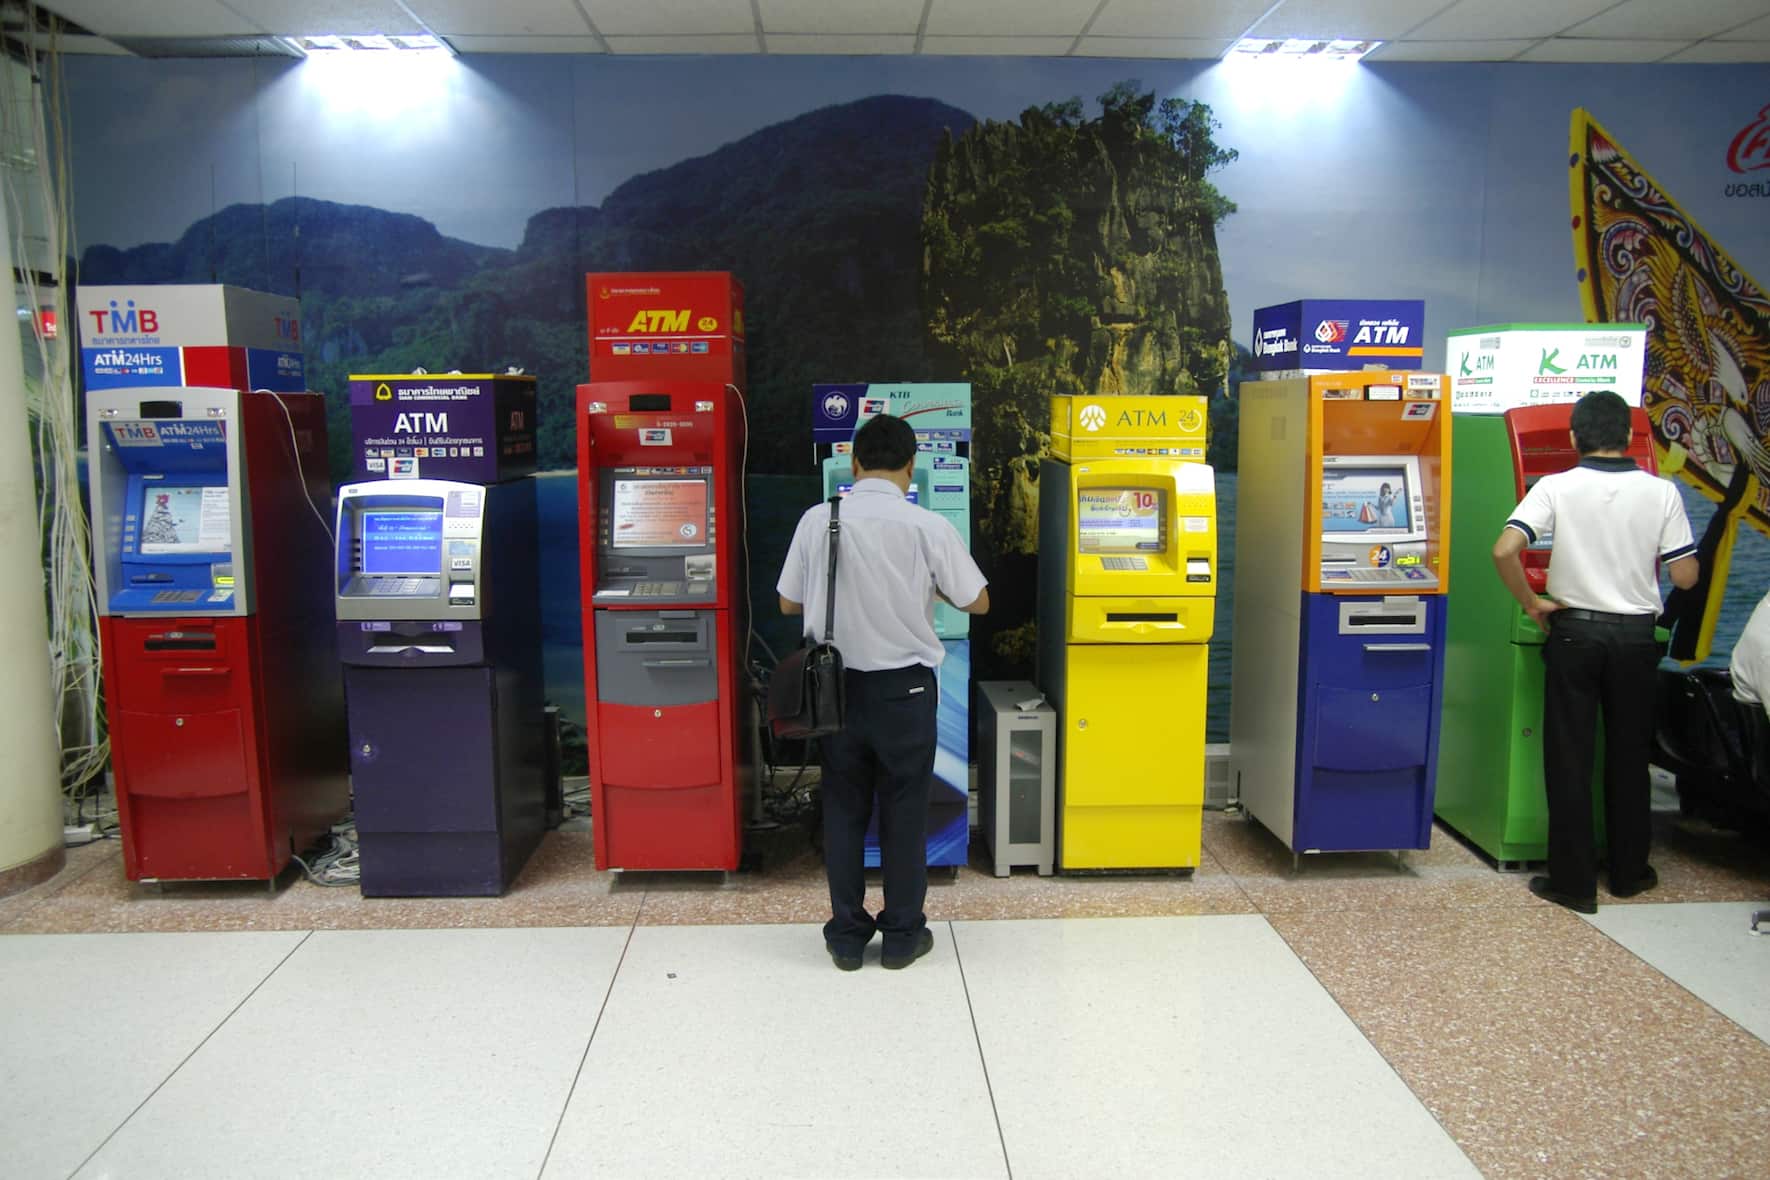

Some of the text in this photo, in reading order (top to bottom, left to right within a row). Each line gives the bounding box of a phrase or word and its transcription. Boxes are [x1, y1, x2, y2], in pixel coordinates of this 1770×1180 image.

[89, 300, 160, 335] TMB
[626, 309, 692, 333] ATM
[1353, 326, 1409, 344] ATM
[1476, 355, 1494, 370] ATM
[1538, 347, 1617, 375] K ATM
[889, 391, 911, 399] KTB
[394, 413, 448, 433] ATM
[1116, 409, 1194, 427] ATM 24
[114, 422, 156, 439] TMB
[1134, 492, 1153, 509] 10
[453, 559, 471, 567] VISA
[1371, 550, 1388, 561] 24
